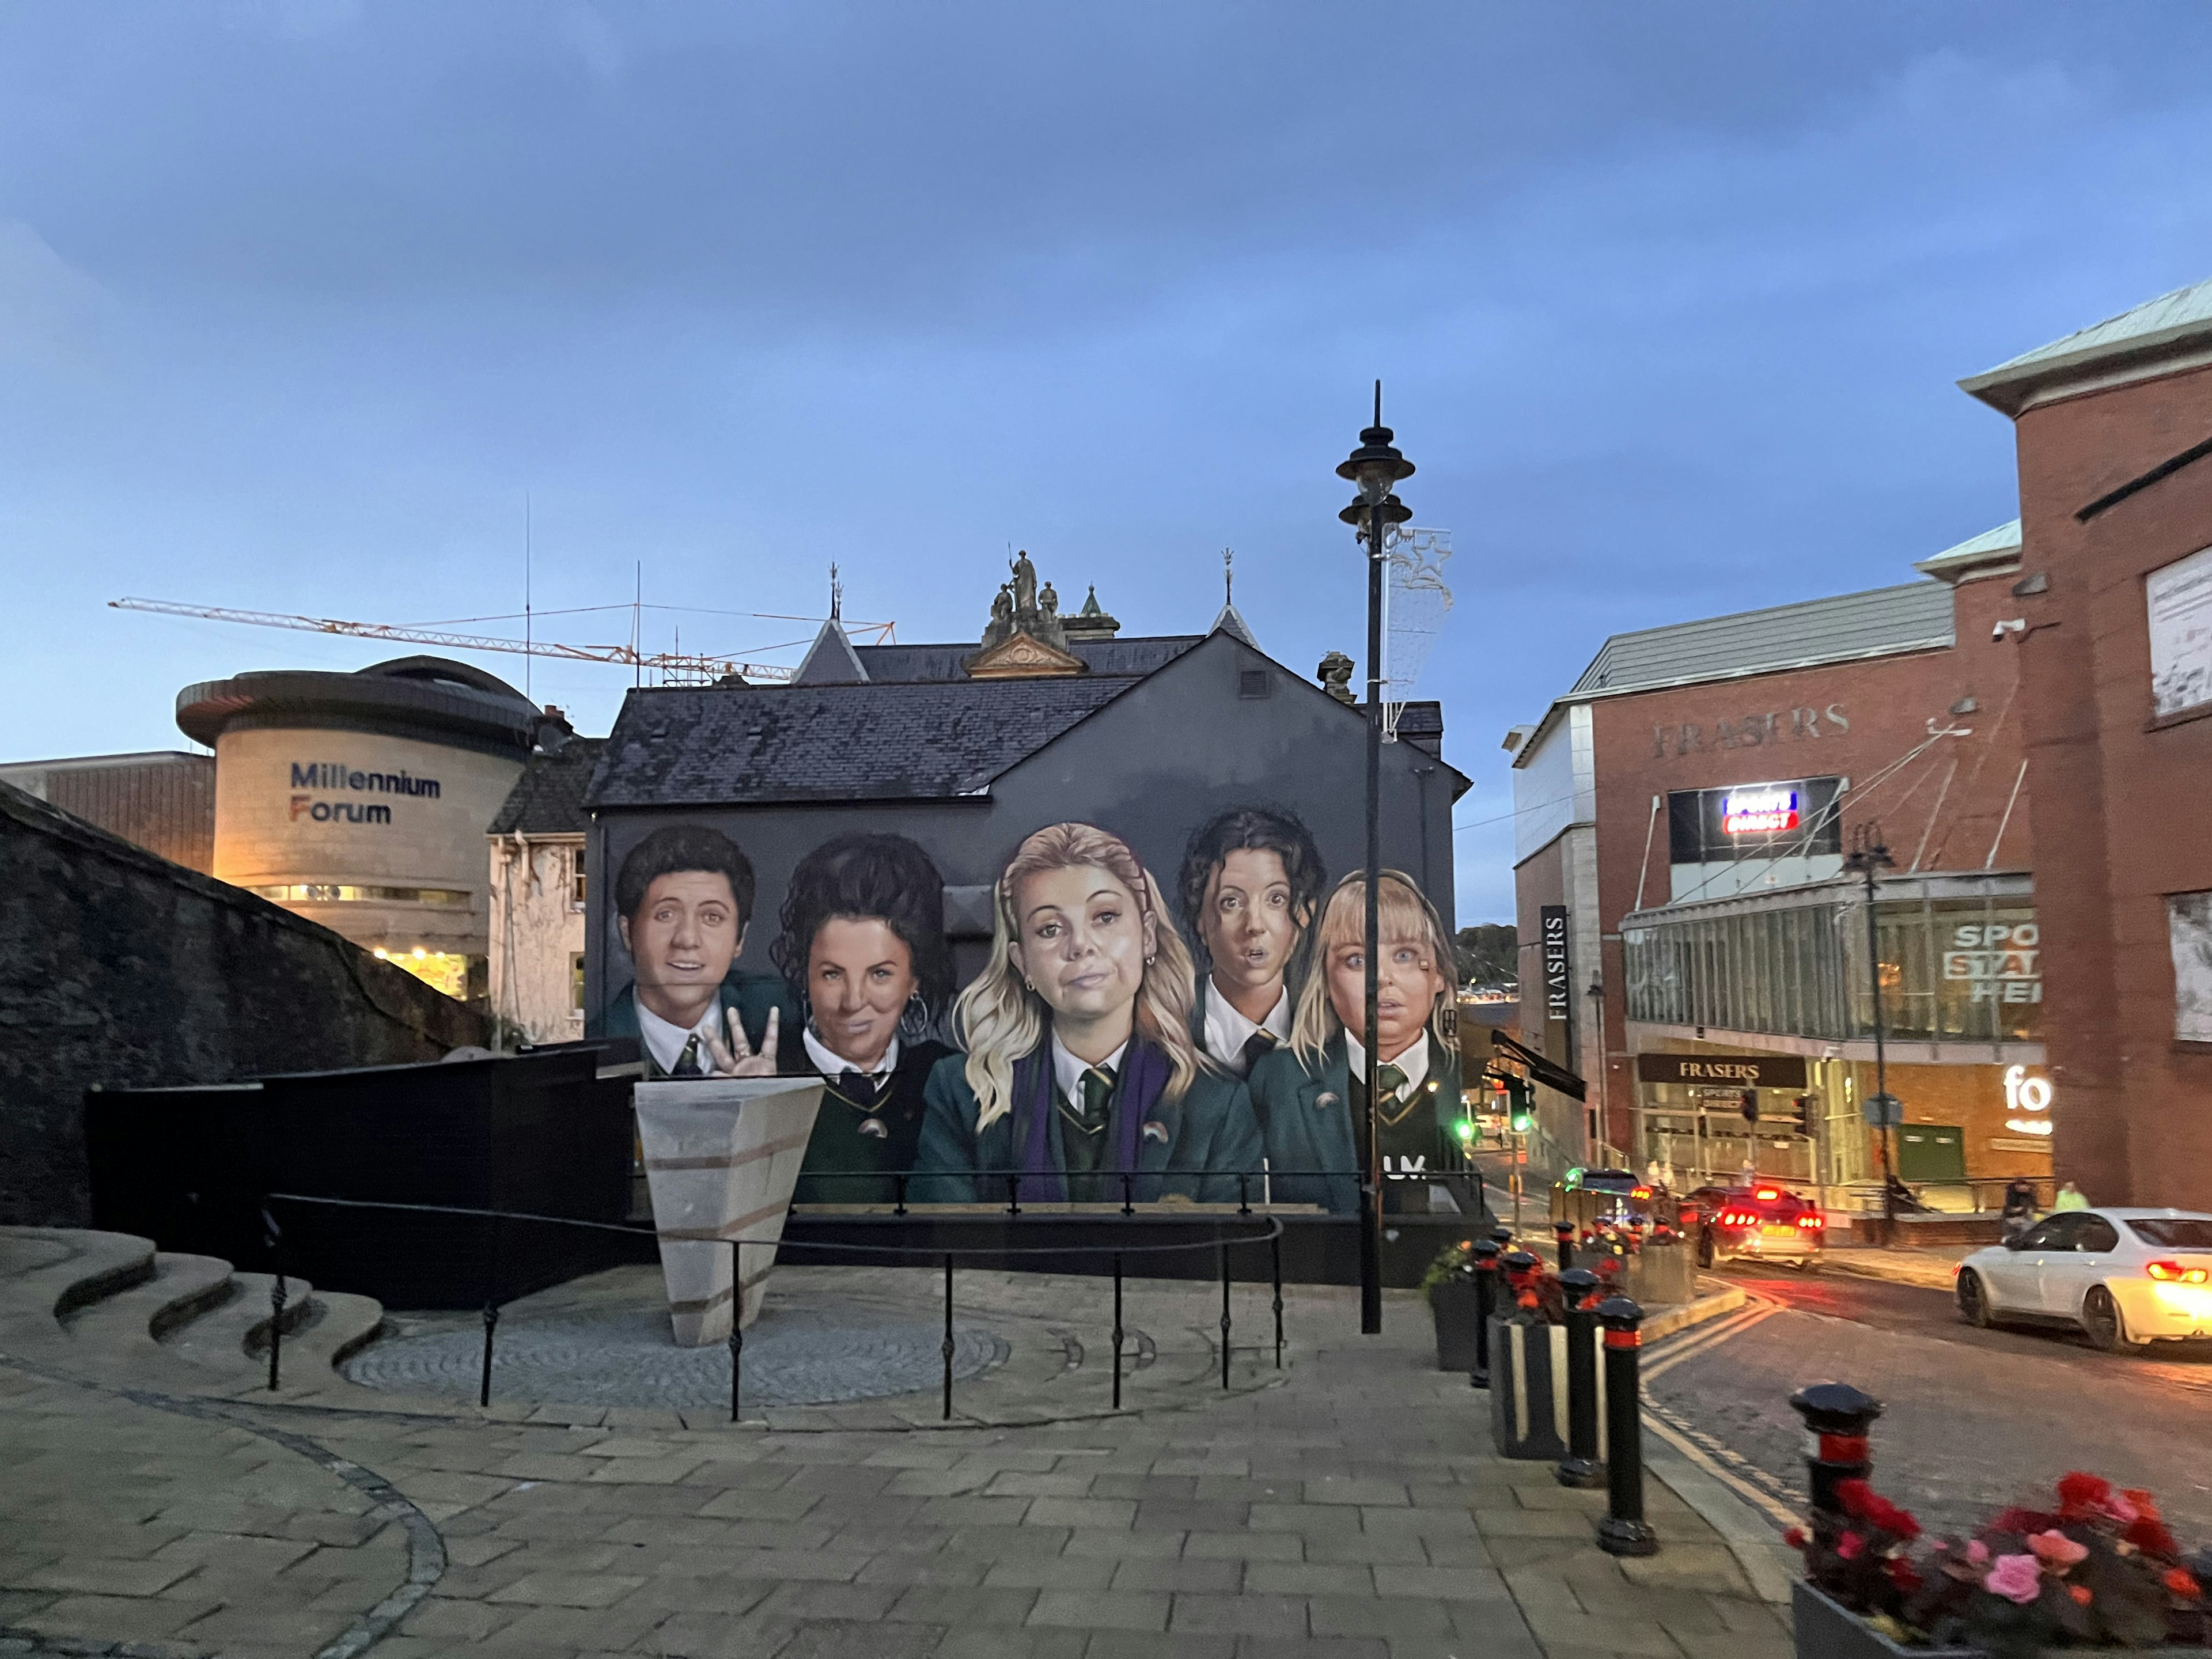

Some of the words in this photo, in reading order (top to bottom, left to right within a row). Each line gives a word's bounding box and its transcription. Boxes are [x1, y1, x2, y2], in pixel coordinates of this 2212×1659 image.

[1654, 704, 1850, 759] FRASERS
[291, 762, 441, 799] Millennium
[289, 794, 392, 824] Forum
[1546, 917, 1567, 1020] FRASERS
[1680, 1062, 1760, 1079] FRASERS
[2003, 1065, 2051, 1111] fo
